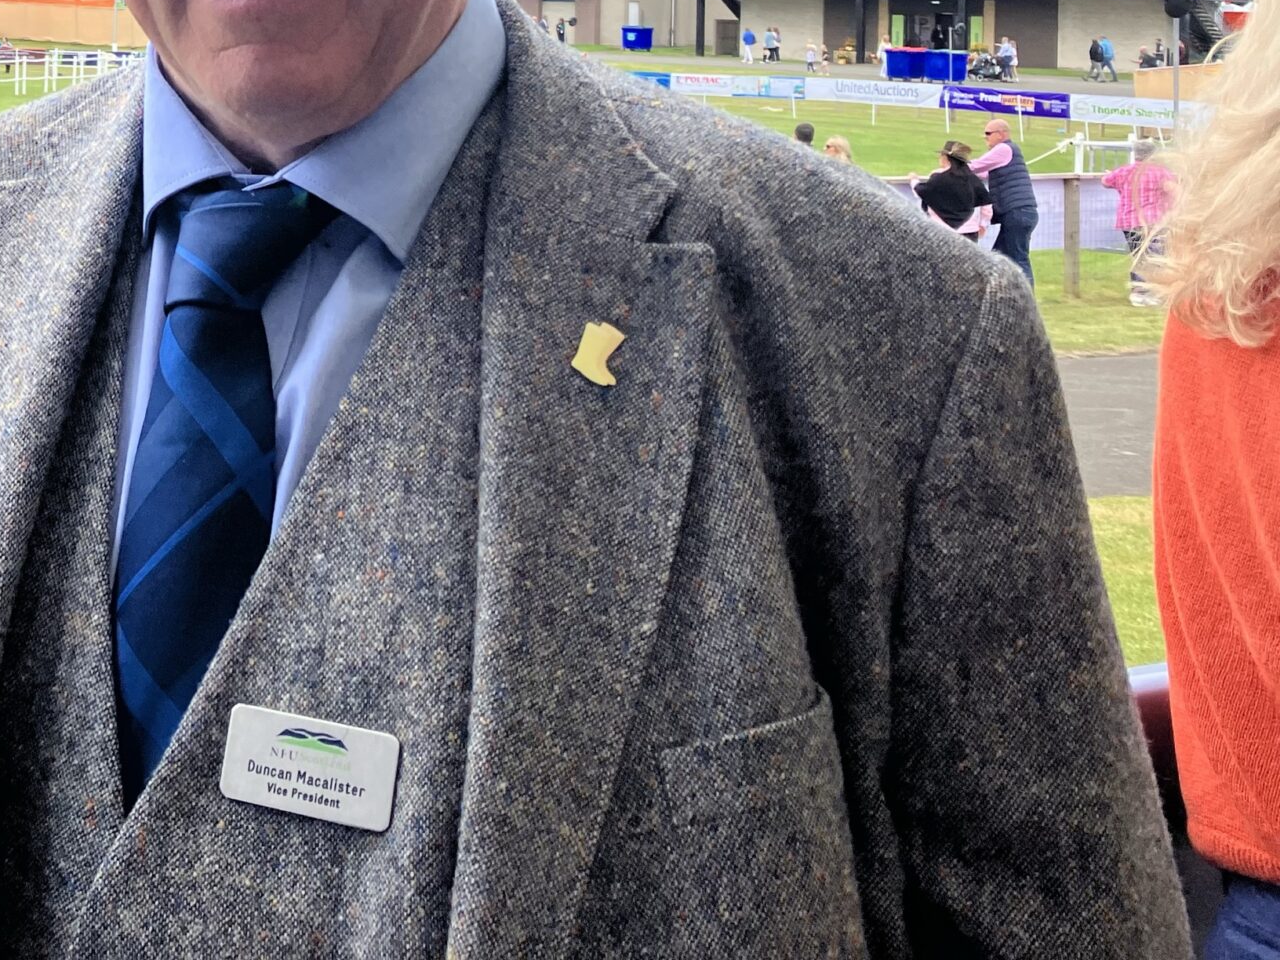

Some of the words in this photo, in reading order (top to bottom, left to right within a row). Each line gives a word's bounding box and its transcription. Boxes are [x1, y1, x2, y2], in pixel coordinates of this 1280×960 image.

[1091, 104, 1132, 117] Thomas
[247, 759, 292, 781] Duncan
[296, 770, 366, 797] Macalister
[267, 783, 288, 797] Vice
[291, 789, 340, 809] President
